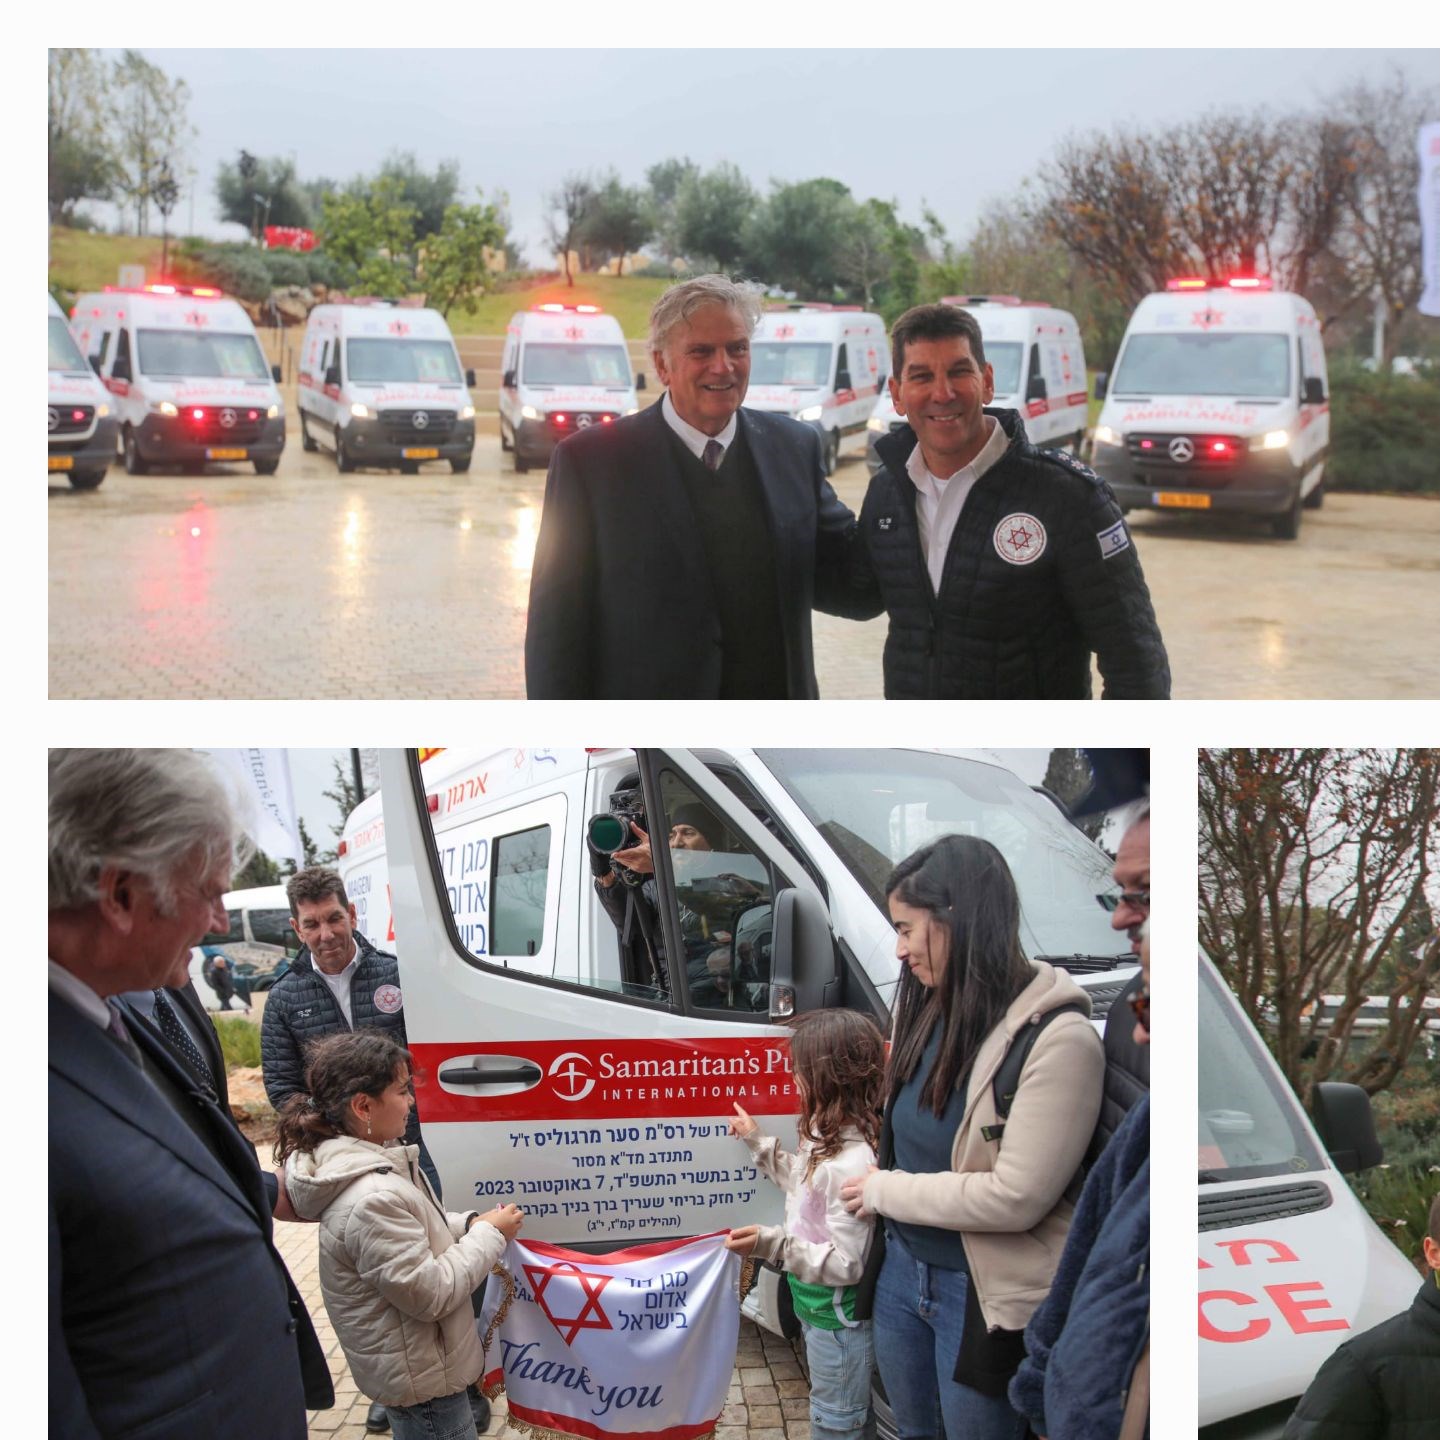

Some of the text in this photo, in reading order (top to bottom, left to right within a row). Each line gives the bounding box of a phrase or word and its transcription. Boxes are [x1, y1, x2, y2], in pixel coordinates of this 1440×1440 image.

[447, 772, 488, 813] ארגון
[603, 1084, 759, 1101] INTERNATIONAL
[534, 1128, 601, 1147] מרגוליס
[606, 1127, 640, 1143] סער
[645, 1123, 685, 1140] רס"מ
[689, 1124, 711, 1138] של
[572, 1150, 693, 1167] מתנדב מד"א מסור
[681, 1171, 730, 1184] בתשרי
[475, 1180, 514, 1196] 2023
[518, 1178, 591, 1195] באוקטובר
[561, 1192, 734, 1216] חזק בריחי שעריך ברך בניך
[661, 1271, 688, 1290] מגן
[645, 1291, 687, 1309] אדום
[618, 1311, 688, 1331] בישראל
[500, 1339, 595, 1395] Thank
[592, 1384, 664, 1416] you
